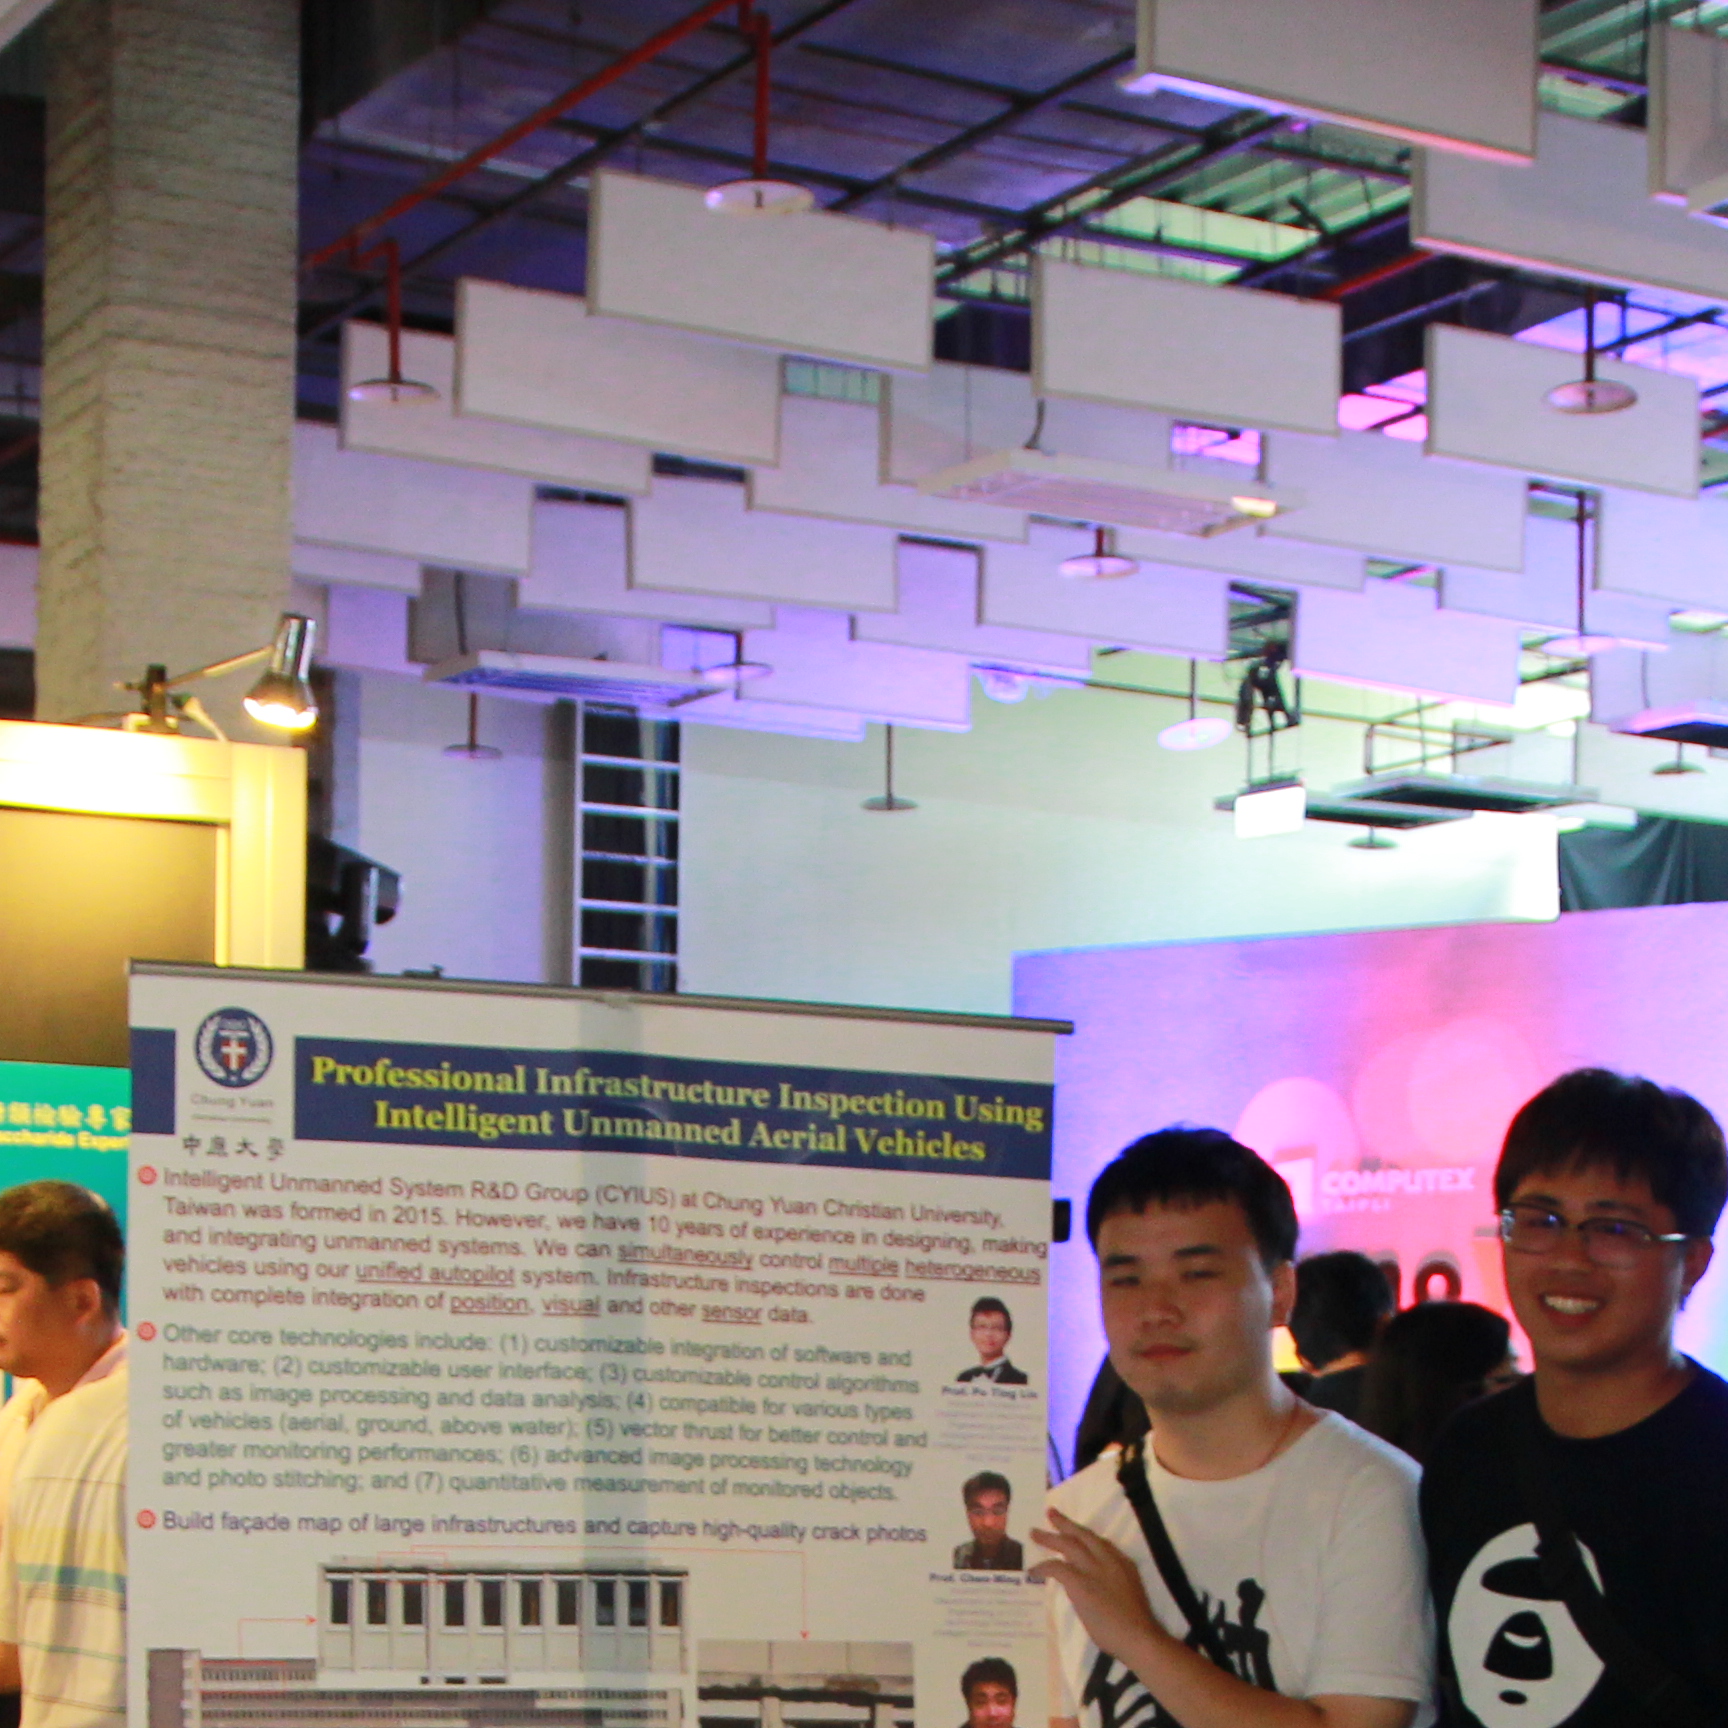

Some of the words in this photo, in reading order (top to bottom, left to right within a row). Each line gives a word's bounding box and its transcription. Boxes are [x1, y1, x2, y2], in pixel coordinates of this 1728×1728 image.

[312, 1058, 526, 1091] Professional
[537, 1071, 770, 1104] Infrastructure
[780, 1087, 946, 1117] Inspection
[955, 1097, 1044, 1128] Using
[375, 1103, 553, 1136] Intelligent
[564, 1112, 741, 1143] Unmanned
[751, 1125, 847, 1150] Aerial
[855, 1130, 987, 1159] Vehicles
[164, 1170, 263, 1192] Intelligent
[270, 1174, 382, 1193] Unmanned
[389, 1177, 464, 1198] System
[470, 1181, 518, 1199] R&D
[524, 1183, 590, 1203] Group
[680, 1193, 697, 1207] at
[702, 1192, 764, 1216] Chung
[769, 1197, 817, 1214] Yuan
[823, 1199, 905, 1219] Christian
[910, 1206, 1003, 1227] University,
[1326, 1167, 1475, 1195] COMPUTEX
[163, 1196, 236, 1215] Taiwan
[242, 1205, 283, 1218] was
[290, 1202, 362, 1221] formed
[368, 1209, 386, 1221] in
[392, 1206, 446, 1224] 2015.
[455, 1211, 549, 1227] However,
[557, 1216, 587, 1228] we
[592, 1214, 641, 1230] have
[649, 1215, 670, 1232] 10
[675, 1222, 724, 1236] years
[729, 1222, 748, 1237] of
[752, 1227, 856, 1243] experience
[861, 1232, 877, 1244] in
[882, 1233, 975, 1253] designing,
[982, 1239, 1048, 1258] making
[163, 1229, 202, 1243] and
[208, 1231, 317, 1251] integrating
[323, 1236, 431, 1251] unmanned
[438, 1240, 525, 1256] systems.
[533, 1239, 568, 1256] We
[574, 1243, 611, 1257] can
[617, 1245, 754, 1269] simultaneously
[759, 1254, 823, 1268] control
[828, 1257, 899, 1277] multiple
[905, 1262, 1041, 1284] heterogeneous
[163, 1257, 247, 1274] vehicles
[253, 1262, 309, 1280] using
[315, 1263, 349, 1277] our
[355, 1262, 423, 1284] unified
[429, 1267, 515, 1287] autopilot
[521, 1270, 599, 1286] system.
[607, 1270, 729, 1290] Infrastructure
[734, 1280, 839, 1296] inspections
[844, 1285, 874, 1299] are
[879, 1286, 926, 1301] done
[162, 1511, 214, 1529] Build
[220, 1513, 291, 1532] façade
[297, 1517, 343, 1533] map
[348, 1513, 369, 1531] of
[374, 1516, 425, 1536] large
[431, 1518, 577, 1533] infrastructures
[583, 1518, 621, 1534] and
[626, 1521, 697, 1536] capture
[702, 1522, 806, 1541] high-quality
[811, 1526, 860, 1539] crack
[866, 1526, 927, 1542] photos
